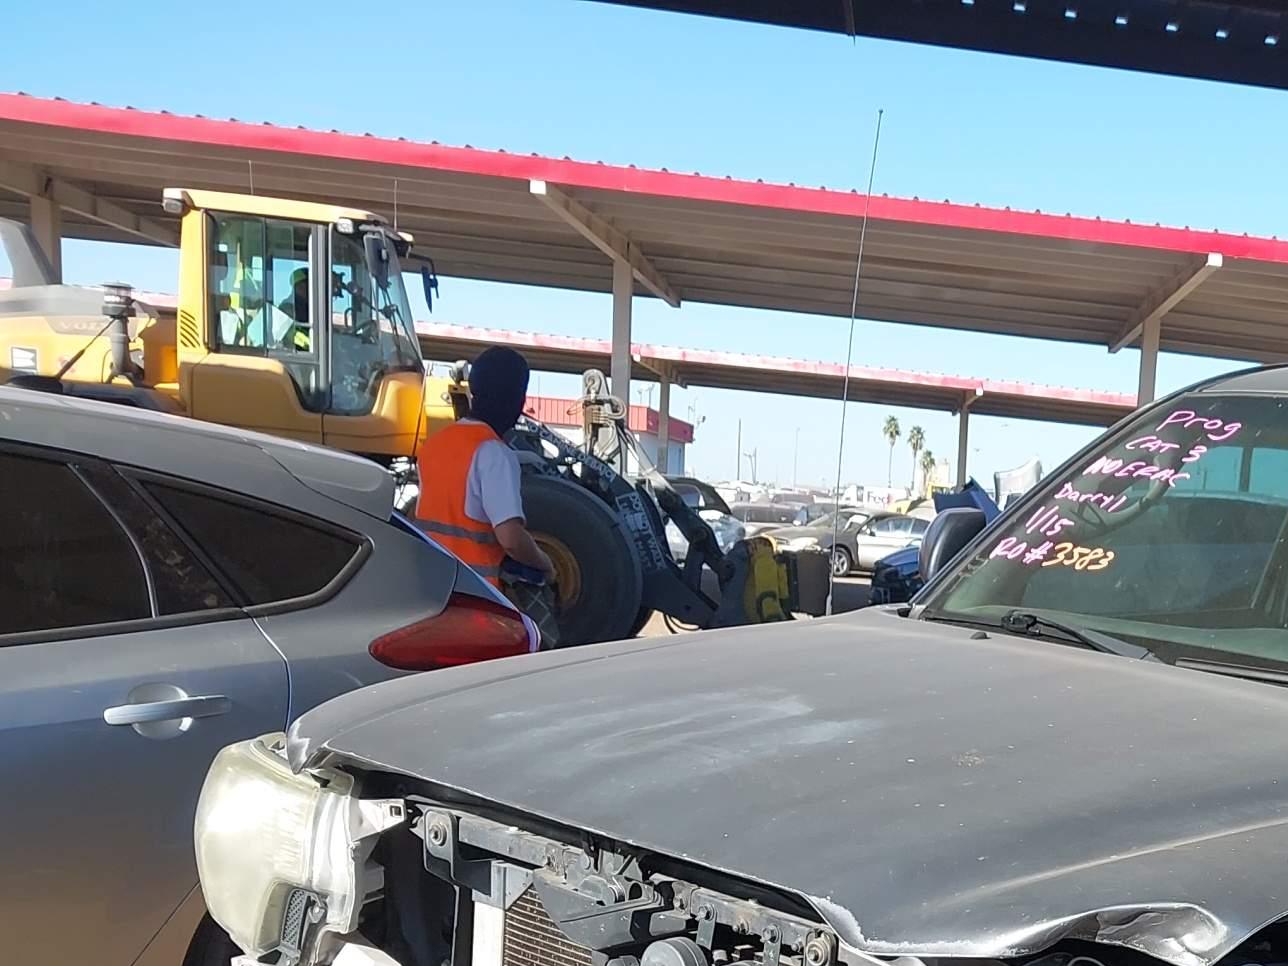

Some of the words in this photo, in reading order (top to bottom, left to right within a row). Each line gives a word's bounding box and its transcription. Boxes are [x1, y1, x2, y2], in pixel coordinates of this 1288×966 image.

[1156, 411, 1242, 441] Prog
[1125, 436, 1180, 453] CAT
[1181, 445, 1207, 462] 3
[1025, 505, 1074, 535] 1/15
